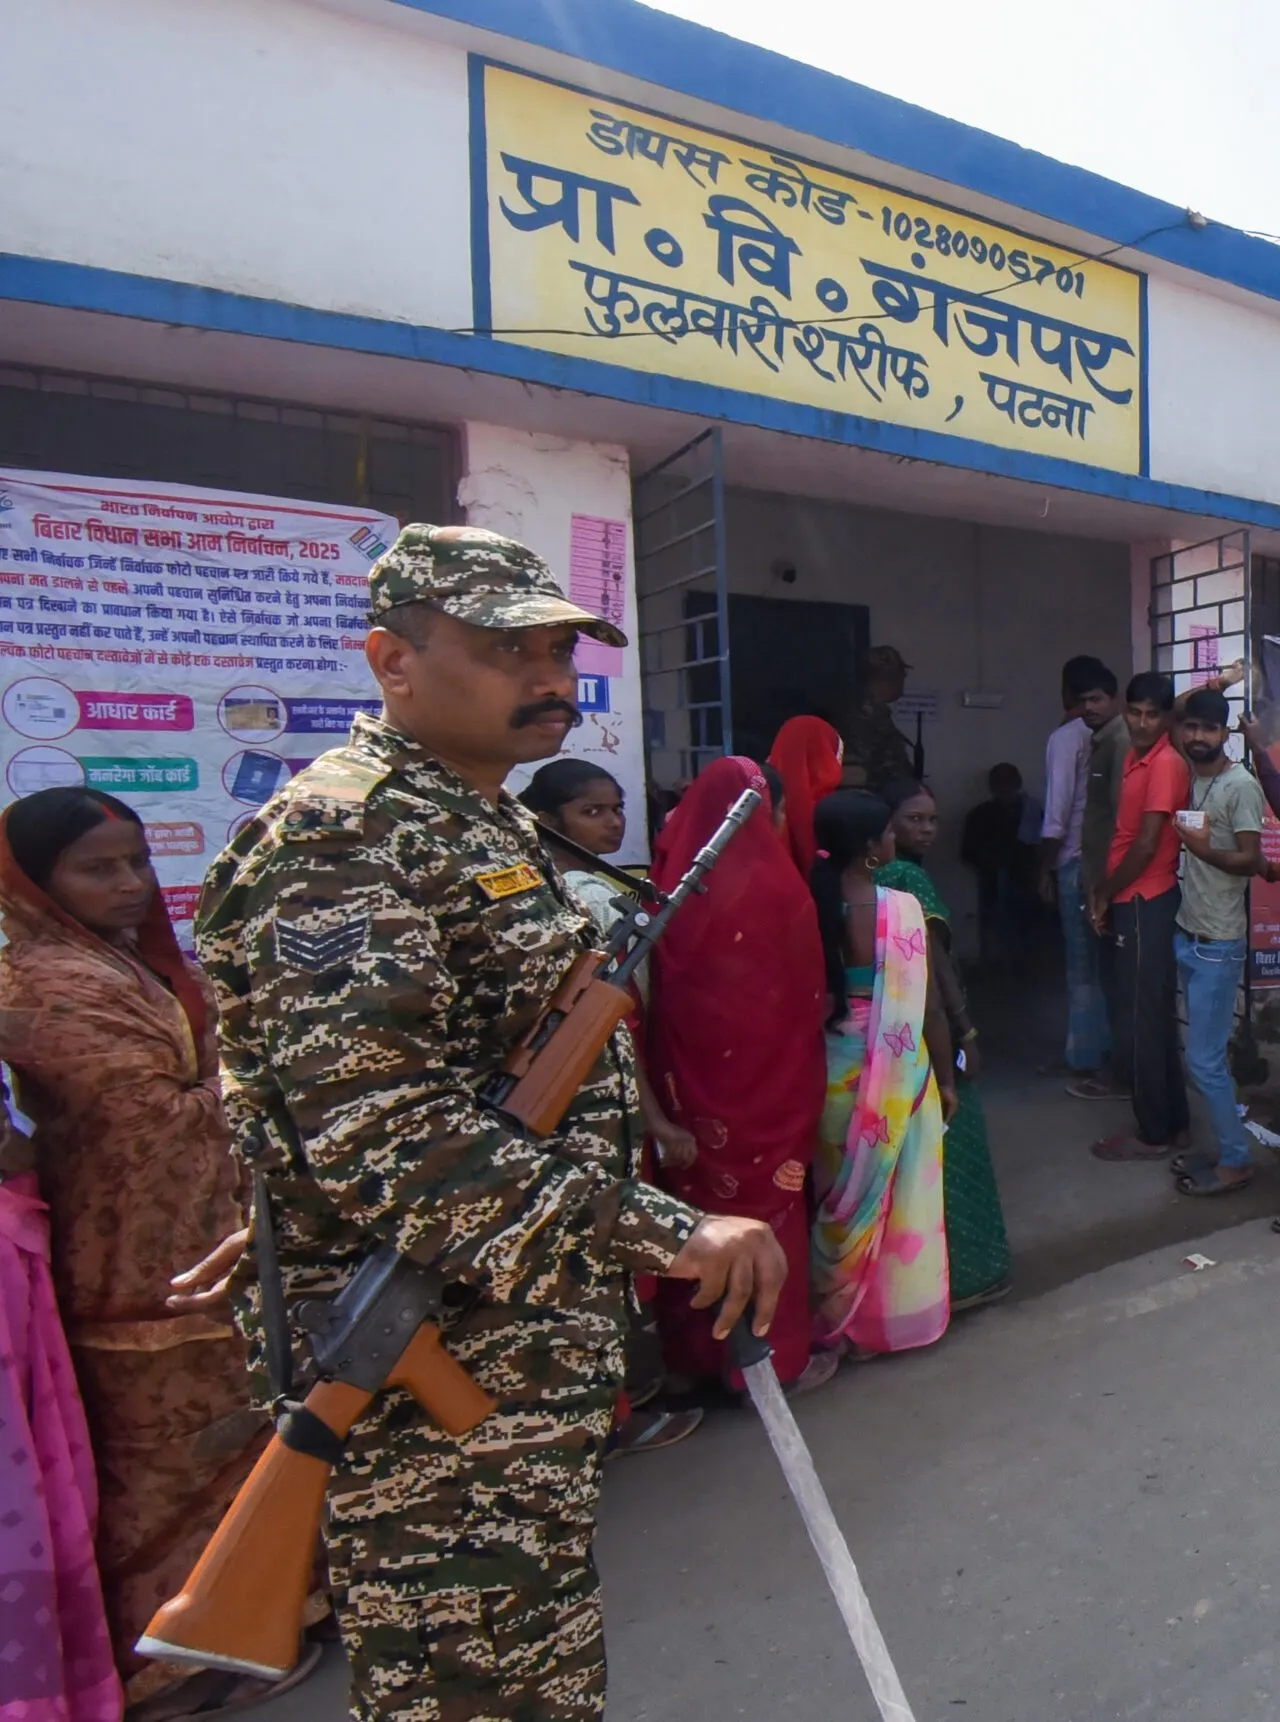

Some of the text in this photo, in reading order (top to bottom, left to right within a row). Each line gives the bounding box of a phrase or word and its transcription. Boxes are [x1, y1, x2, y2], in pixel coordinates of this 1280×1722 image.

[585, 109, 732, 189] डायस
[979, 372, 1096, 440] पटना
[100, 500, 274, 530] भारत निर्वाचन आयोग द्वारा
[32, 513, 82, 541] बिहार
[84, 518, 138, 545] विधान
[141, 528, 182, 548] सभा
[186, 532, 223, 552] आम
[299, 541, 340, 560] 2025
[11, 547, 38, 563] सभी
[166, 560, 192, 577] फोटो
[195, 565, 230, 579] पहचान
[233, 568, 248, 580] पत्र
[250, 566, 276, 582] जारी
[0, 572, 25, 586] पना
[28, 574, 48, 588] मत
[51, 576, 84, 591] डालने
[87, 577, 99, 592] से
[102, 579, 129, 595] पहले
[133, 581, 164, 597] अपनी
[167, 586, 203, 600] पहचान
[254, 589, 281, 605] करने
[303, 594, 332, 606] अपना
[16, 597, 34, 610] पत्र
[81, 601, 97, 614] का
[101, 603, 141, 618] प्रावधान
[146, 603, 173, 620] किया
[176, 607, 198, 621] गया
[286, 612, 299, 626] जो
[16, 622, 33, 635] पत्र
[69, 621, 92, 638] नहीं
[93, 625, 111, 638] कर
[113, 625, 132, 640] पाते
[171, 629, 201, 644] अपनी
[203, 632, 238, 646] पहचान
[280, 634, 304, 648] करने
[307, 634, 317, 648] के
[28, 643, 55, 659] फोटो
[286, 658, 314, 671] करना
[86, 699, 177, 721] आधार कार्ड
[88, 764, 136, 782] मनरेगा
[164, 764, 191, 782] कार्ड
